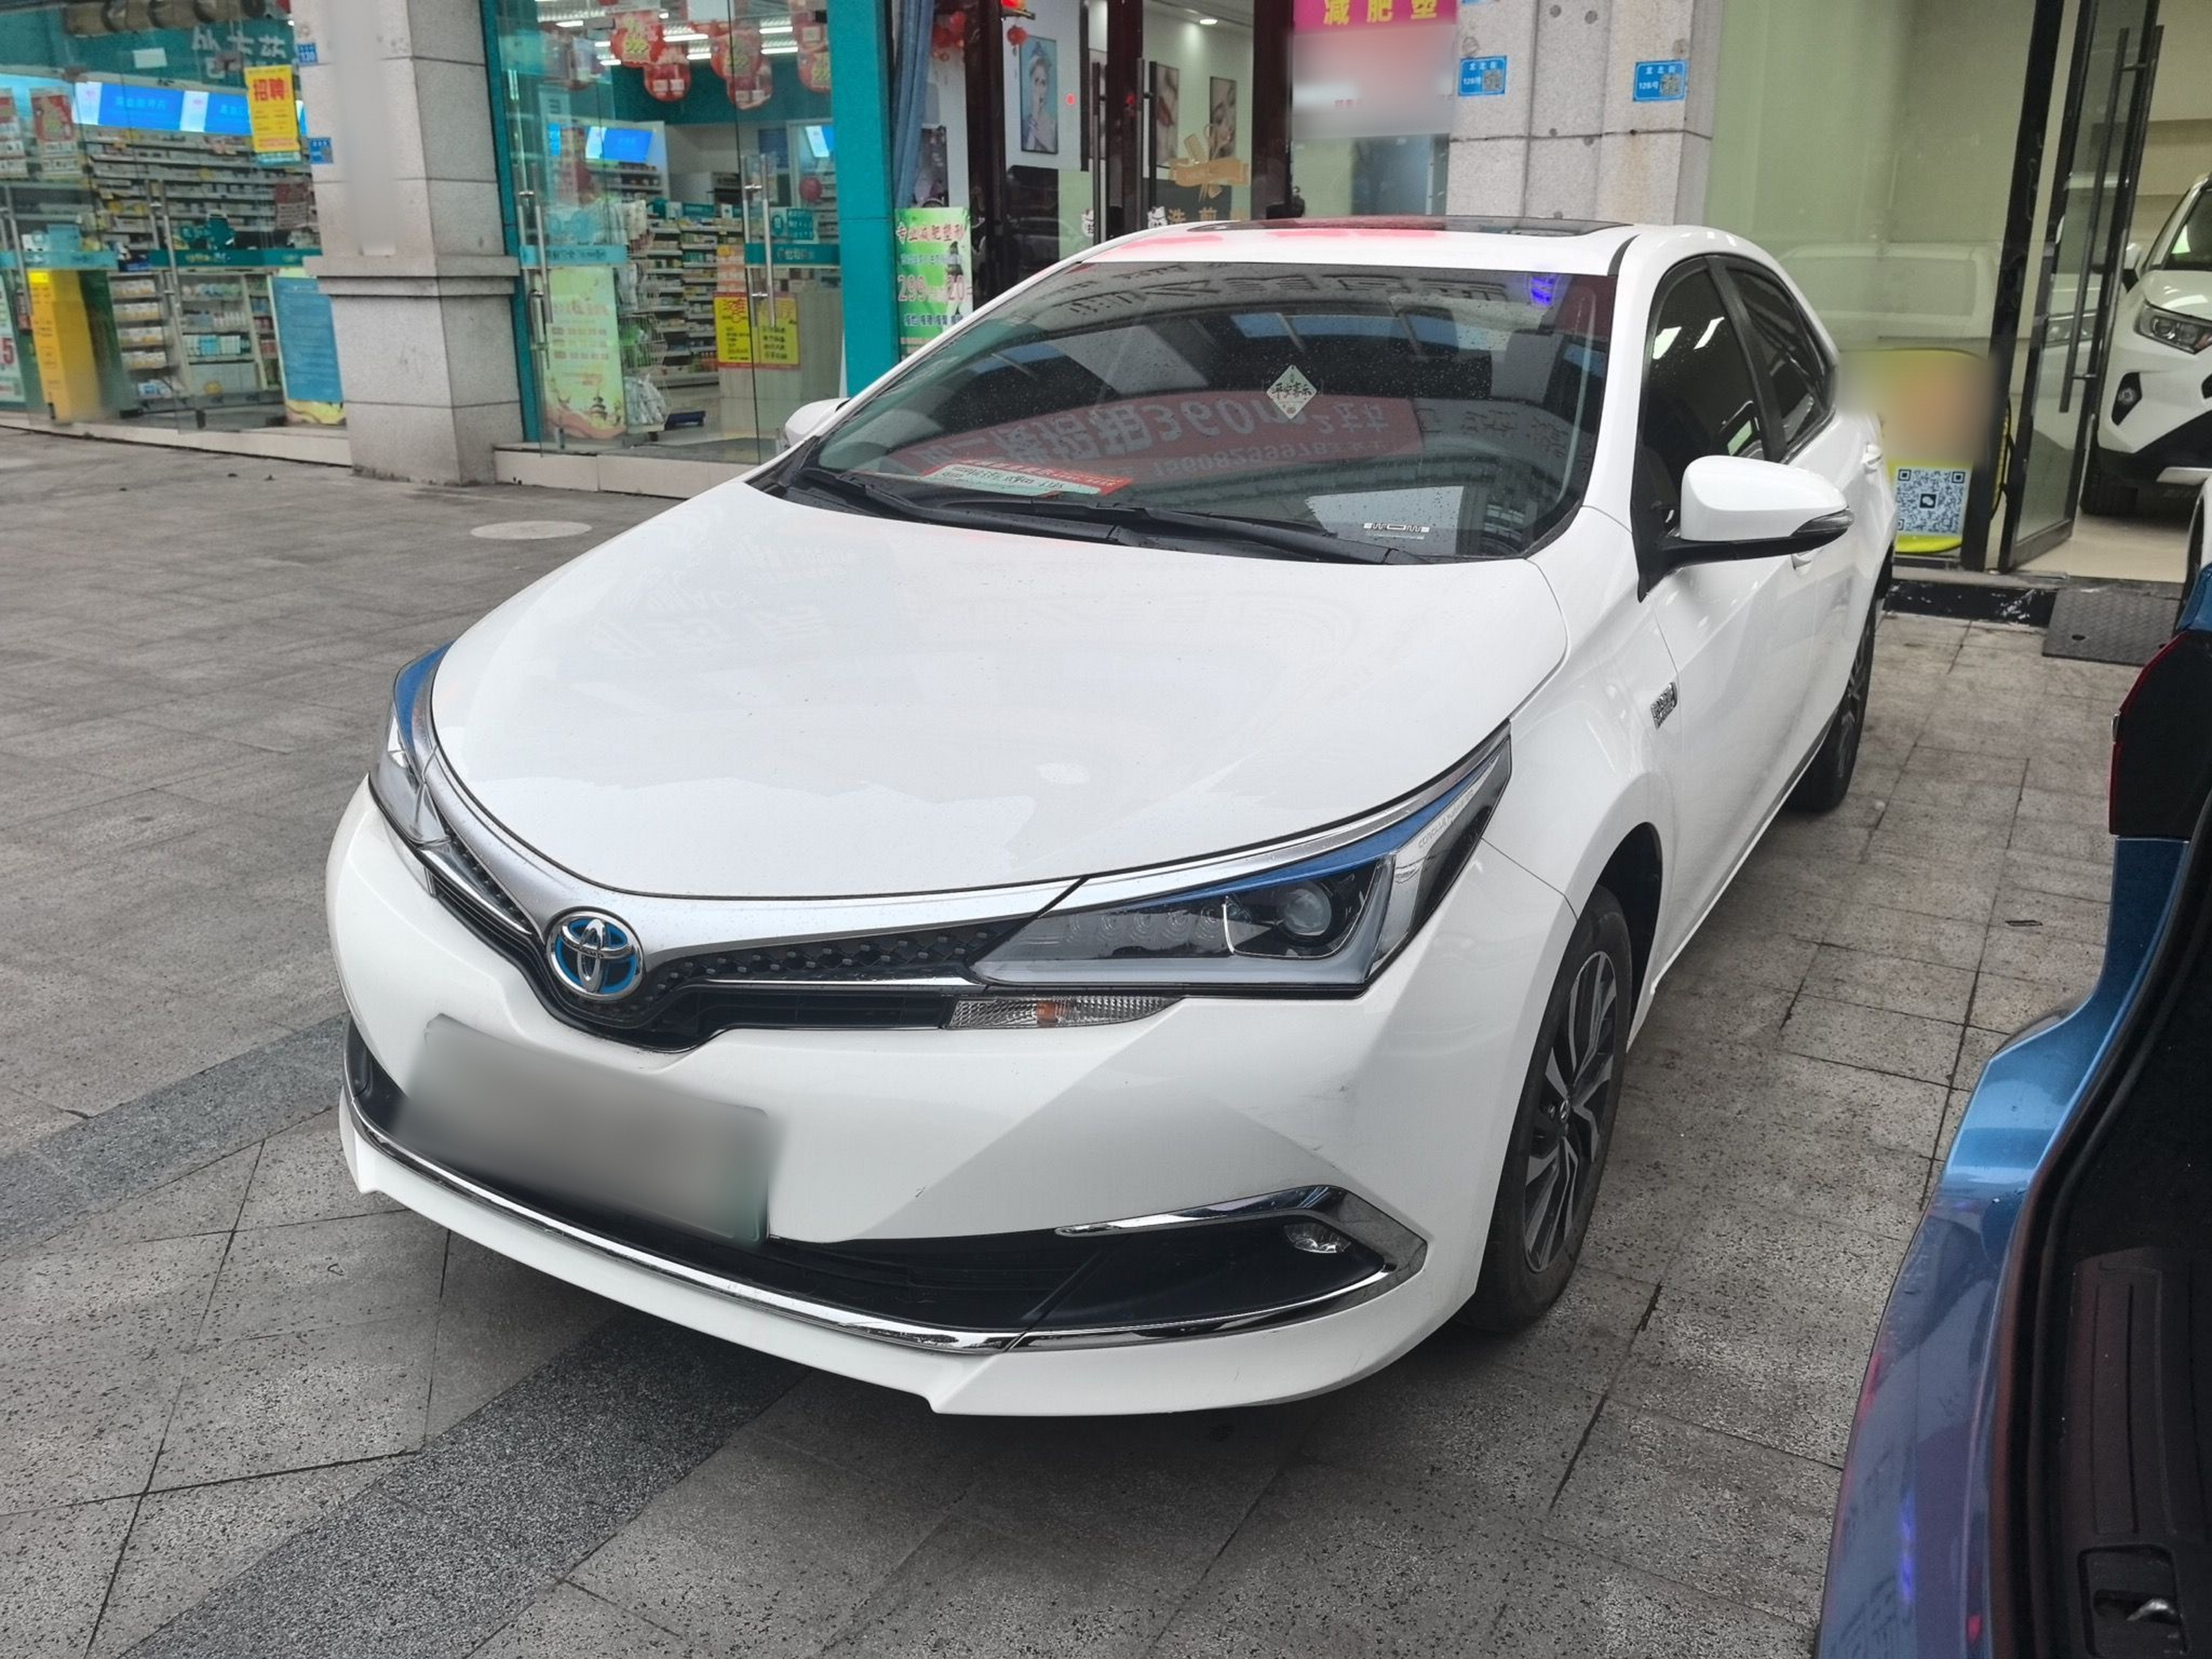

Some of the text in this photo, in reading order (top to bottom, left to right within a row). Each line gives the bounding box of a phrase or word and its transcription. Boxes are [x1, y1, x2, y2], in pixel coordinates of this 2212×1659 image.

[253, 77, 285, 101] 招聘
[1271, 381, 1312, 400] 平安喜乐
